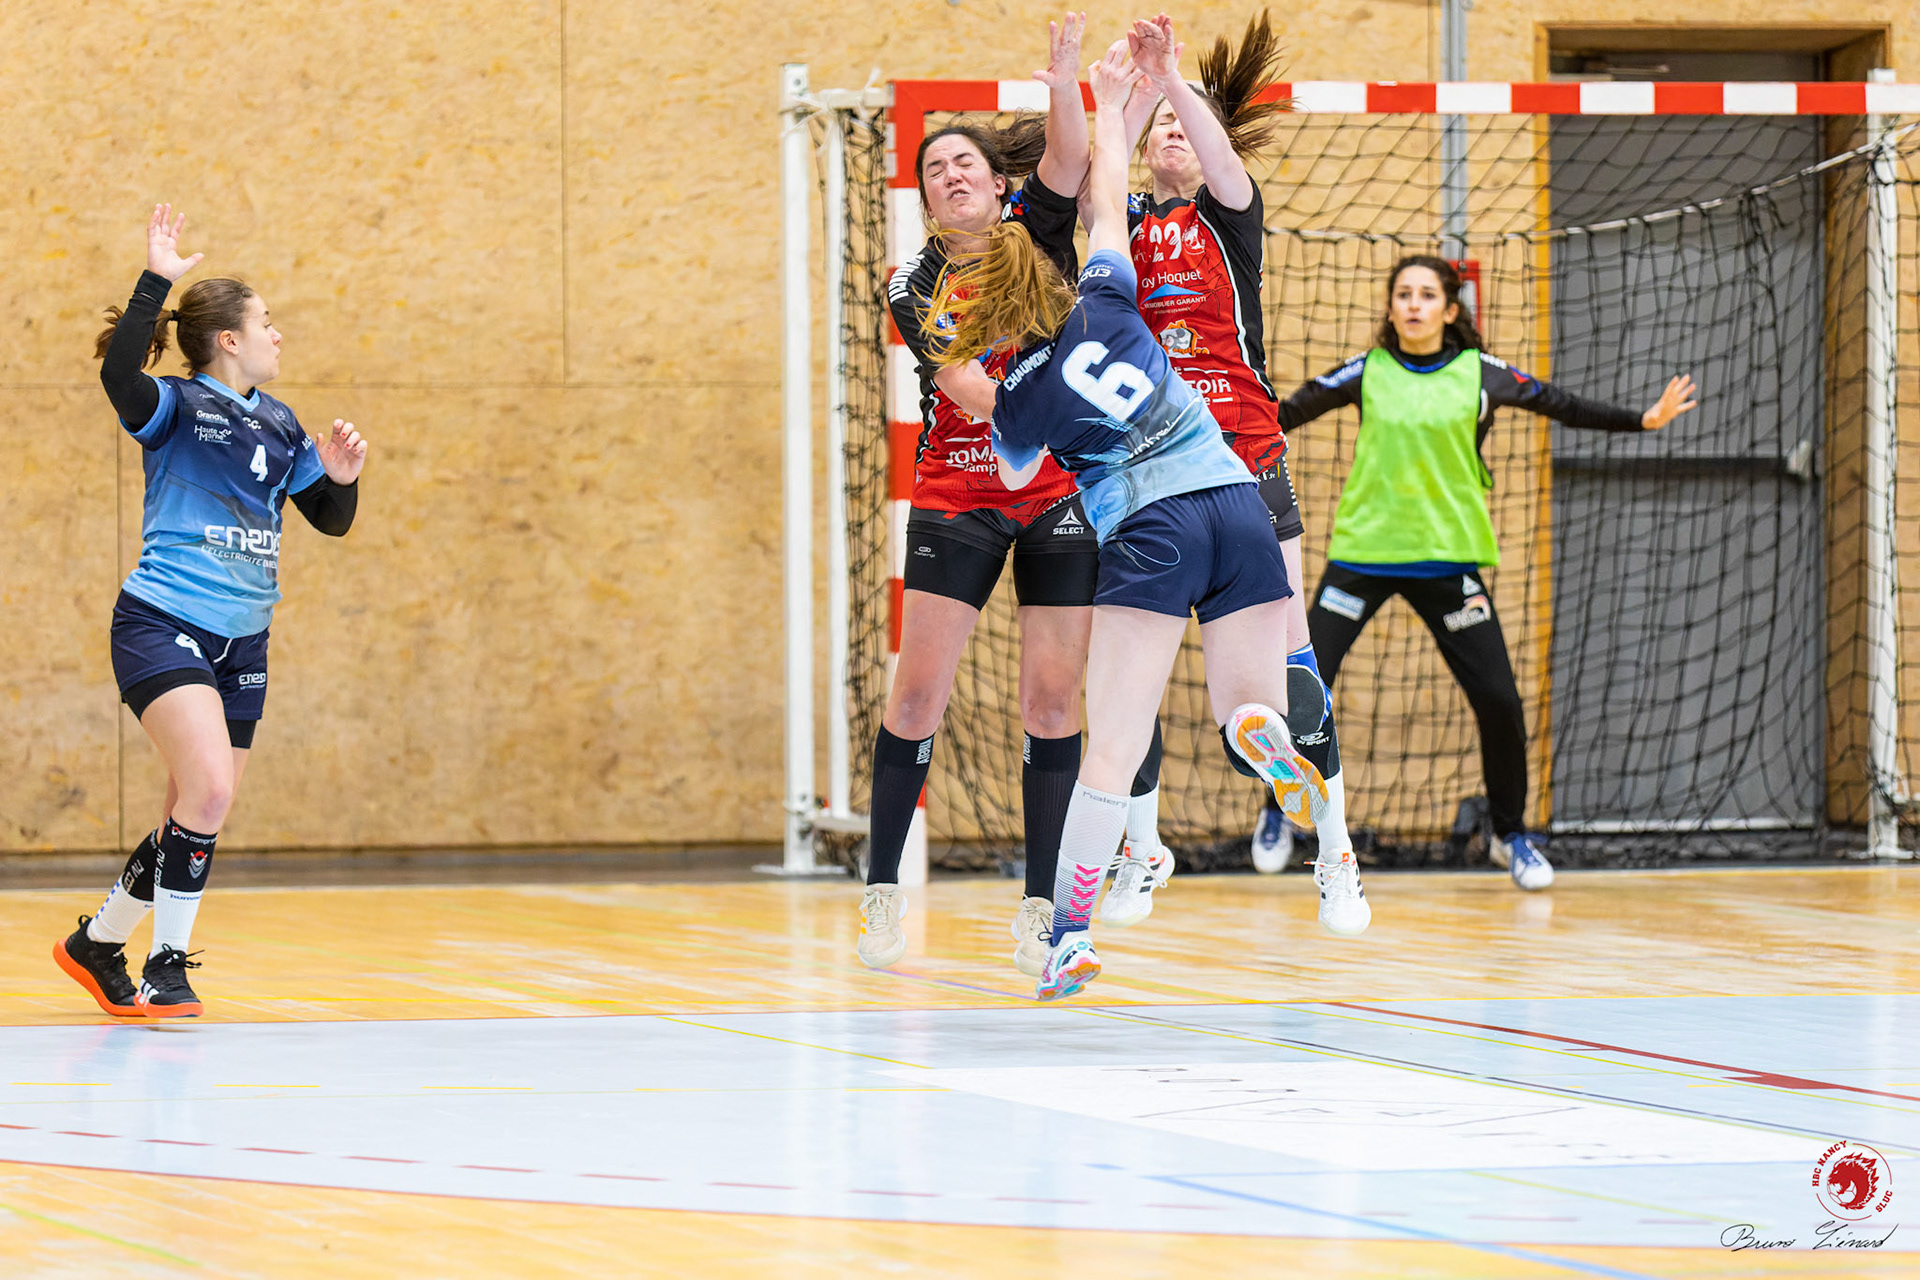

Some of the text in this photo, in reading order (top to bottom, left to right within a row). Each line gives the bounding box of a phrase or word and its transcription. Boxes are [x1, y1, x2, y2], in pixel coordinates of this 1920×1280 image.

[1157, 269, 1203, 285] Hoquet
[1176, 296, 1207, 306] GARANTI
[1003, 345, 1052, 392] CHAUMONT
[1061, 340, 1155, 422] 6
[194, 424, 217, 434] Haute
[198, 431, 224, 442] Marne
[249, 444, 268, 482] 4
[1052, 526, 1085, 535] SELECT
